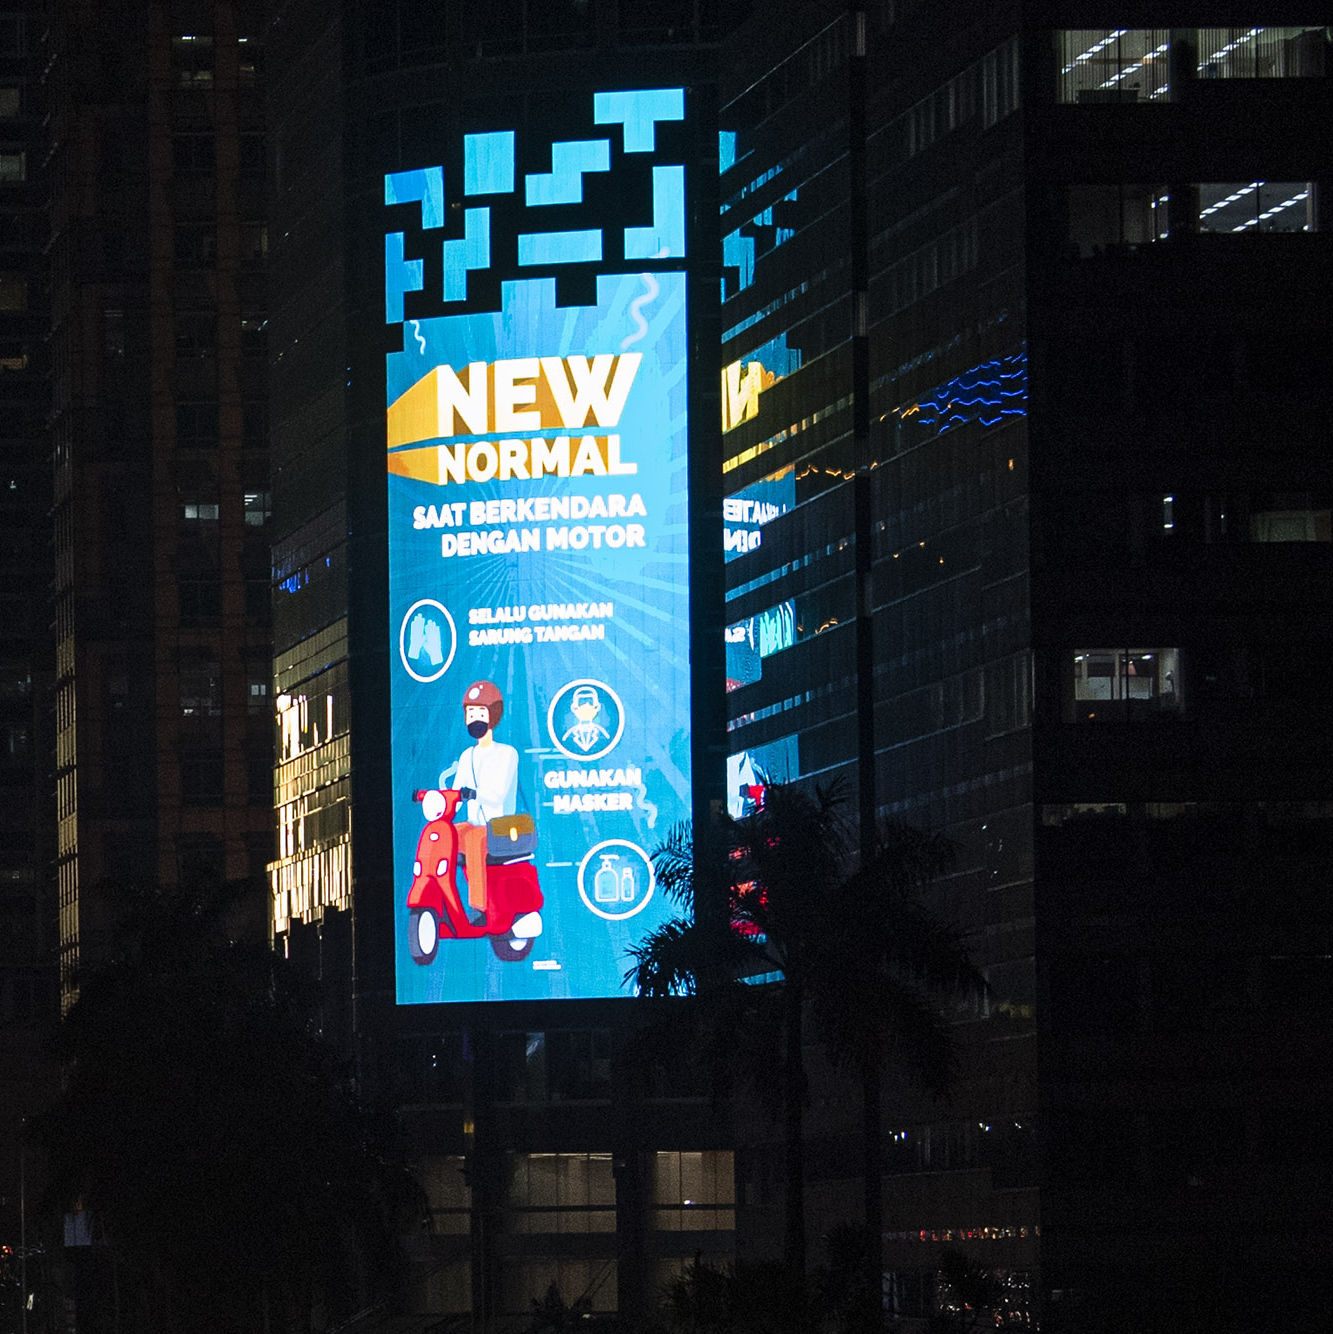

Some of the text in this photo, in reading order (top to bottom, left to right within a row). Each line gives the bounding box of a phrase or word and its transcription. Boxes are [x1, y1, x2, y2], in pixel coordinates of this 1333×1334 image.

[436, 352, 643, 438] NEW
[437, 434, 638, 486] NORMAL
[412, 493, 648, 530] SAAT BERKENDARA
[441, 524, 647, 558] DENGAN MOTOR
[468, 602, 614, 625] SELALU GUNAKAN
[468, 624, 605, 647] SARUNG TANGAN
[544, 767, 642, 788] GUNAKAN
[553, 792, 633, 814] MASKER
